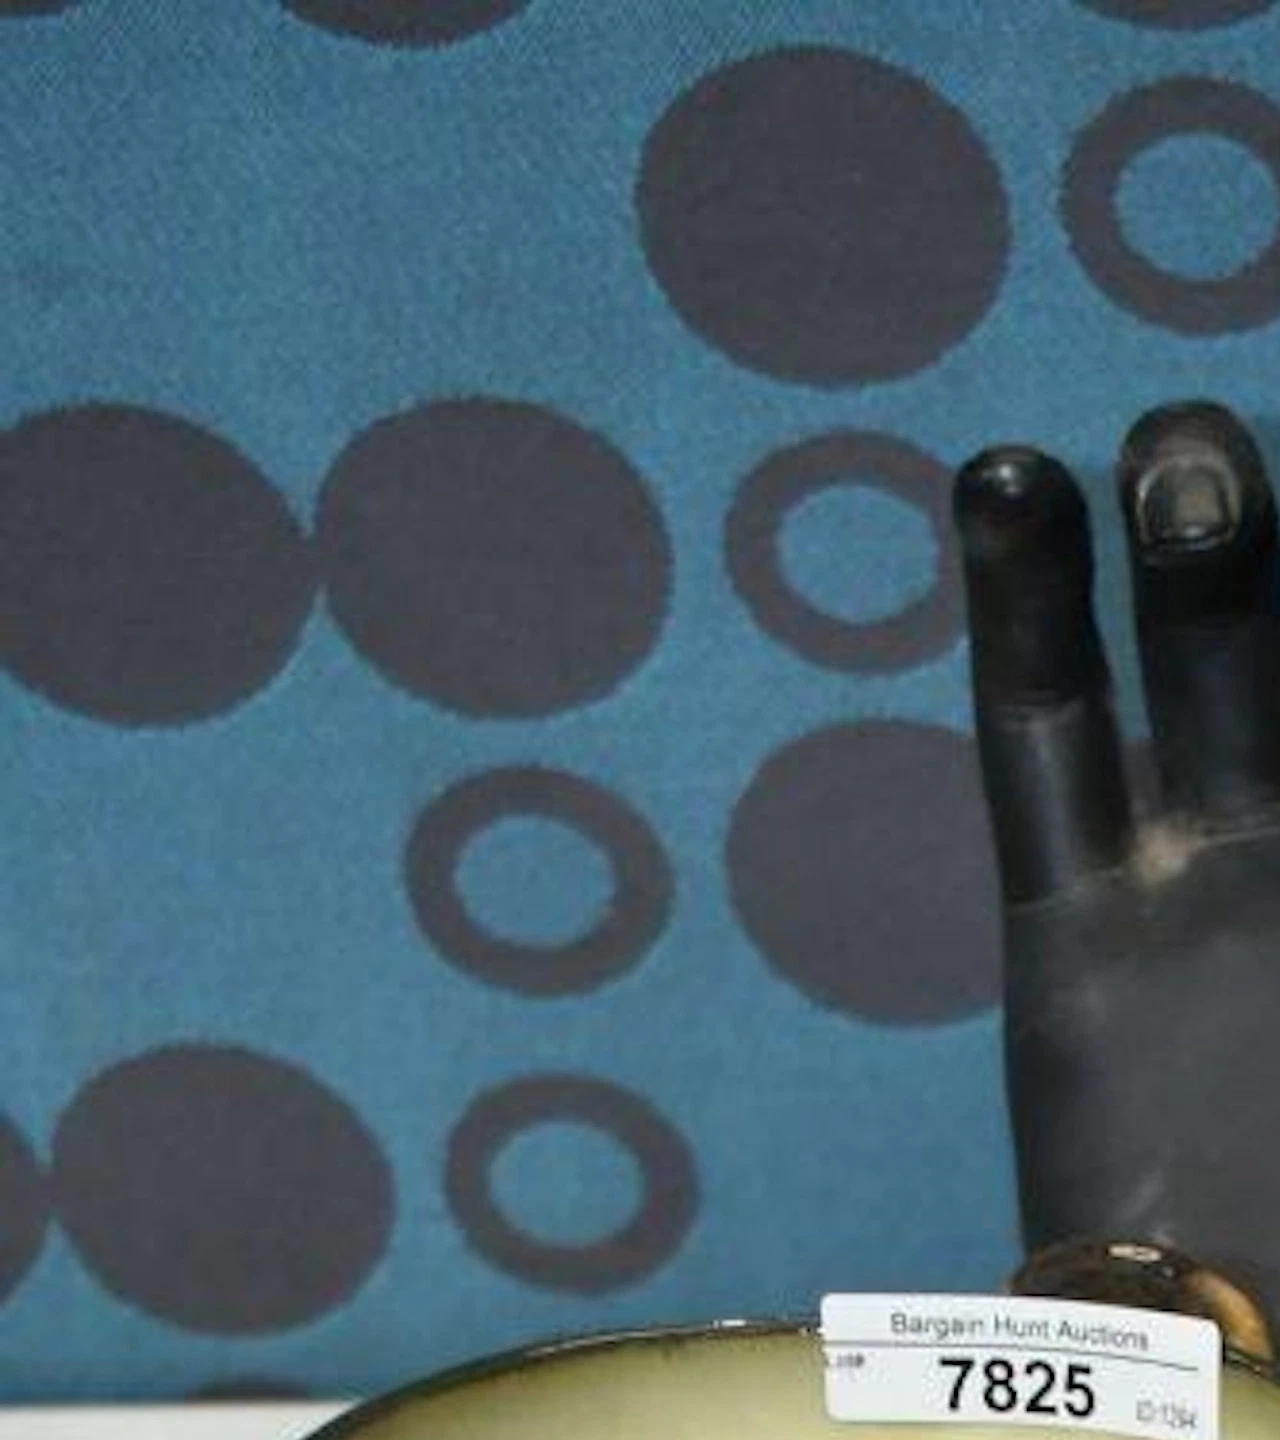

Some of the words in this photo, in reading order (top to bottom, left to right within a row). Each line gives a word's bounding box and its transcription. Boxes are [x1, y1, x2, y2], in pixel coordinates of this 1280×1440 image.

[890, 1312, 984, 1340] Bargain
[993, 1313, 1049, 1339] Hunt
[1057, 1319, 1150, 1350] Auctions
[939, 1357, 1097, 1418] 7825
